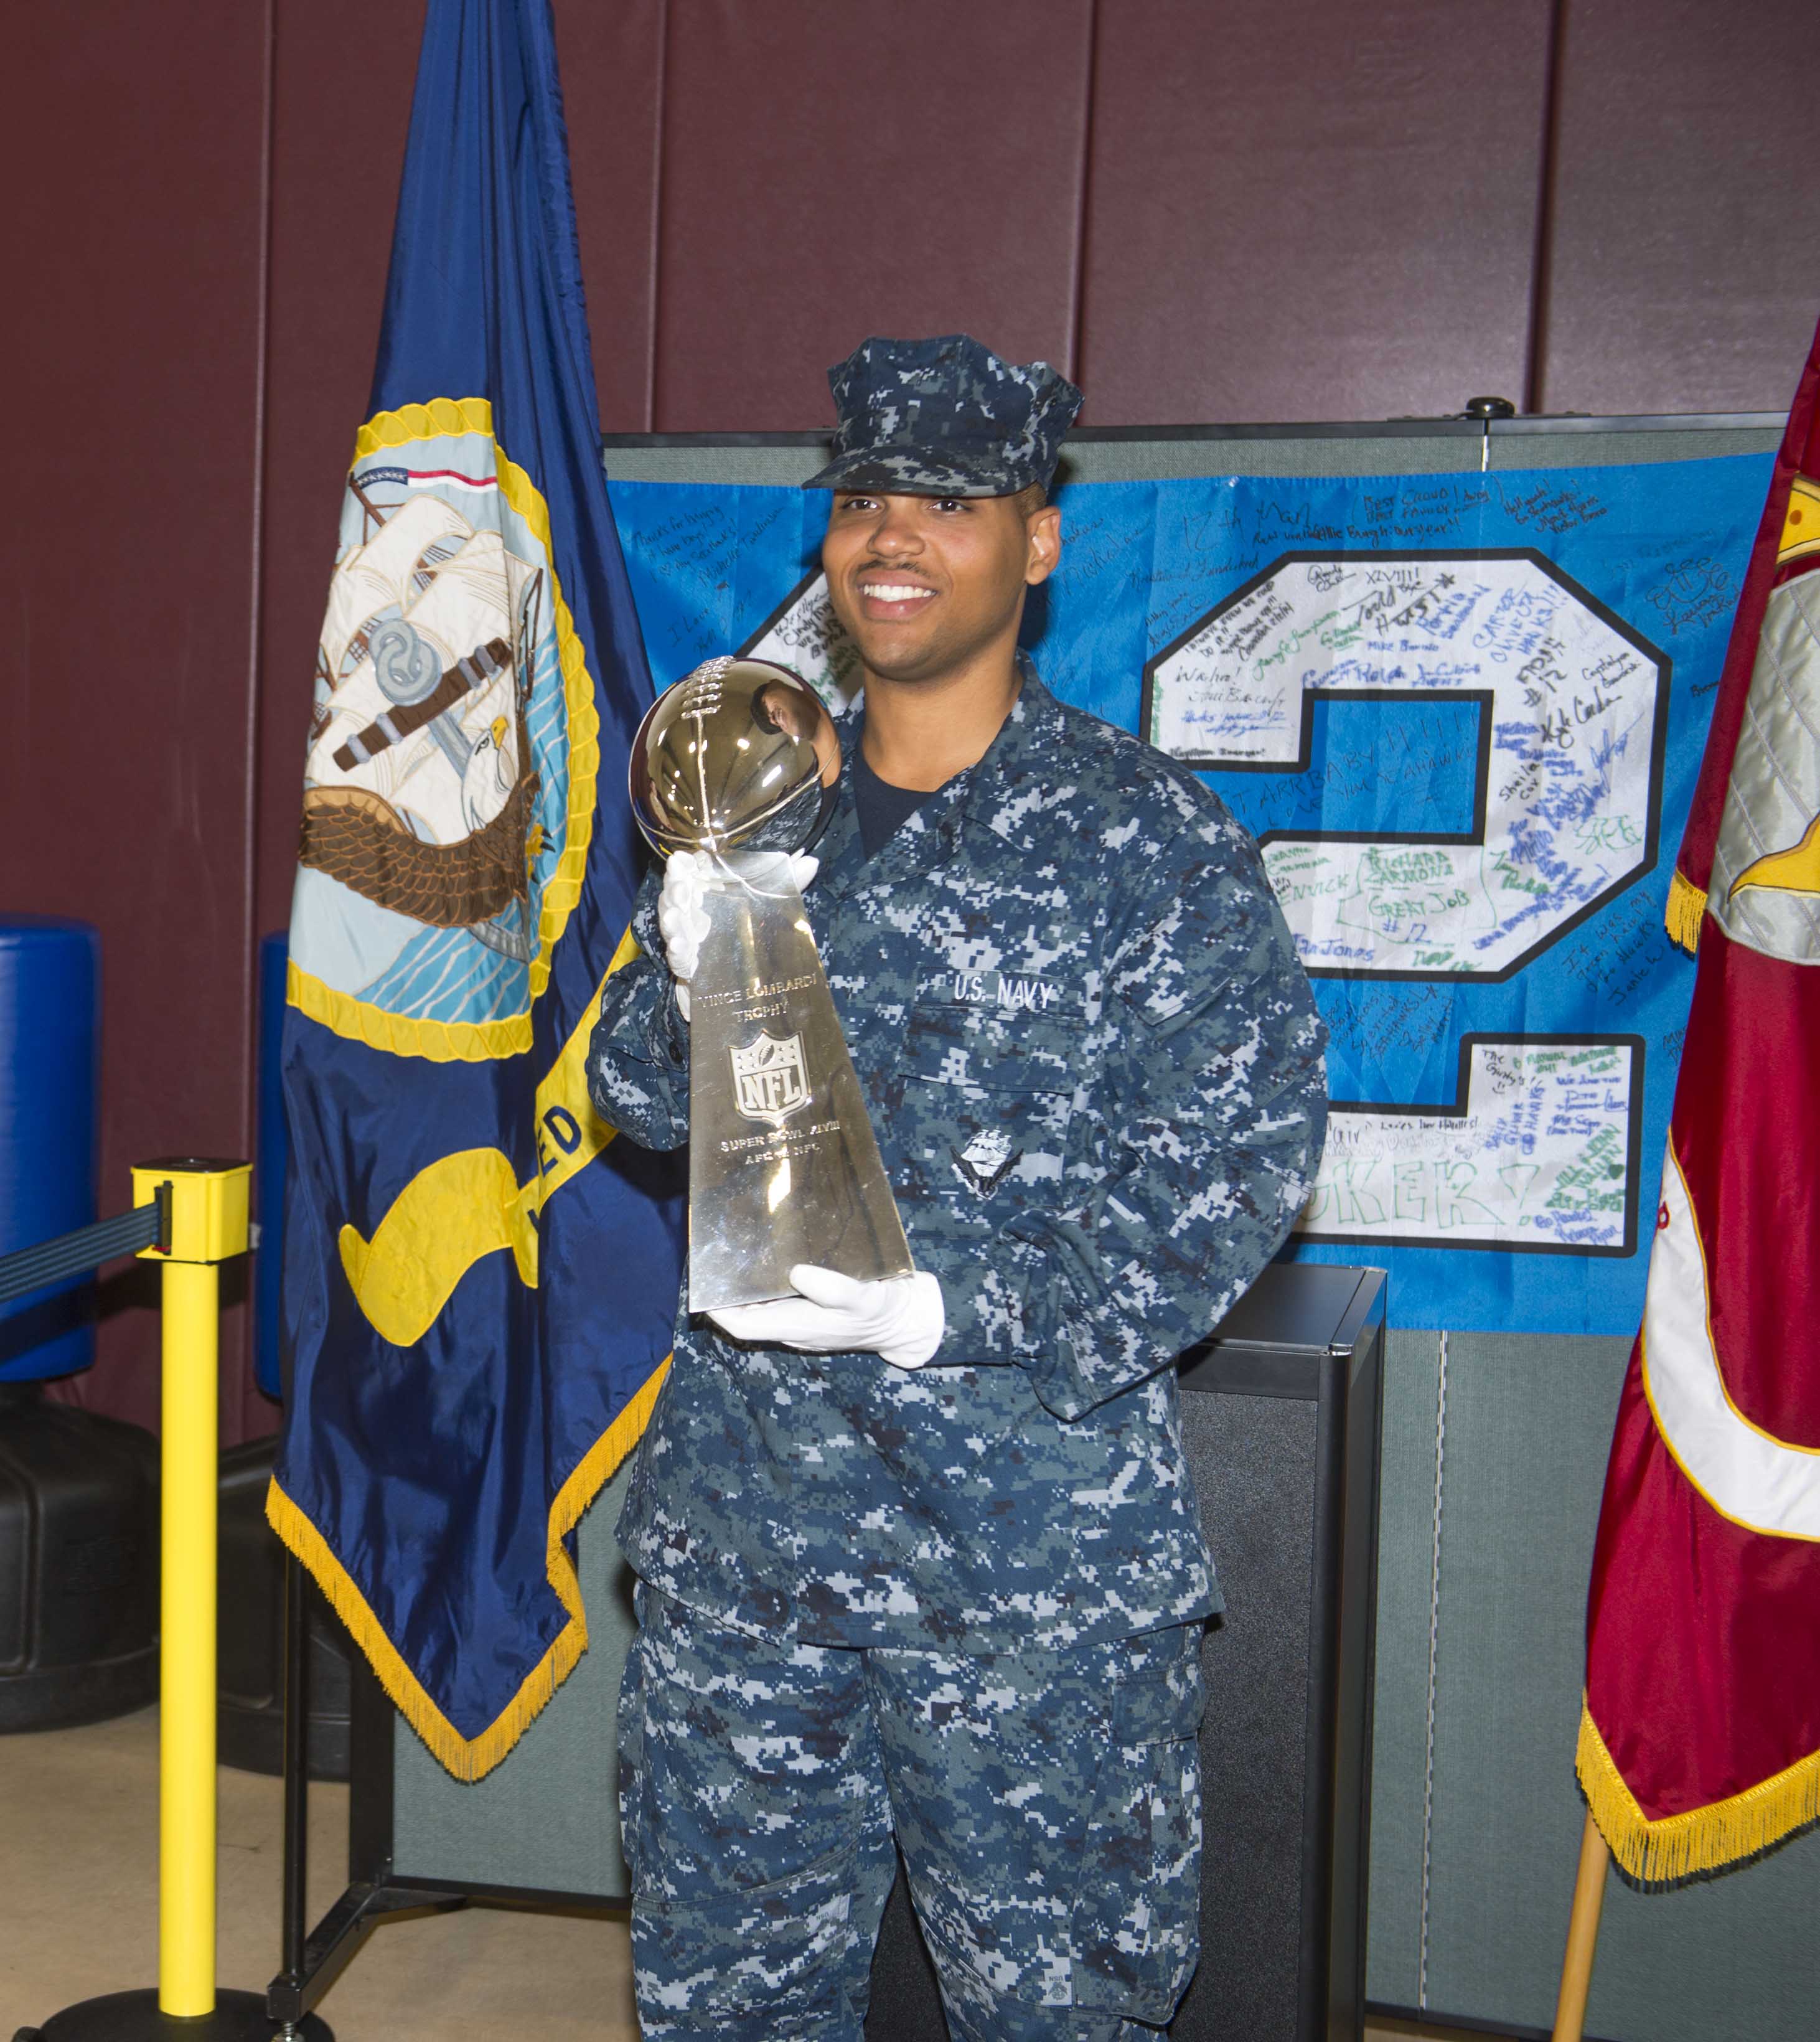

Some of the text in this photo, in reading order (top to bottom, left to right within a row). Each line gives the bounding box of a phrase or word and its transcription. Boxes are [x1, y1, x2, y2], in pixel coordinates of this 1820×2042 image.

[698, 972, 817, 1008] VINCE LOMBARDI
[954, 974, 1054, 1009] U.S. NAVY
[733, 997, 789, 1023] TROPHY
[741, 1067, 801, 1110] NFL
[720, 1136, 765, 1152] SUPER
